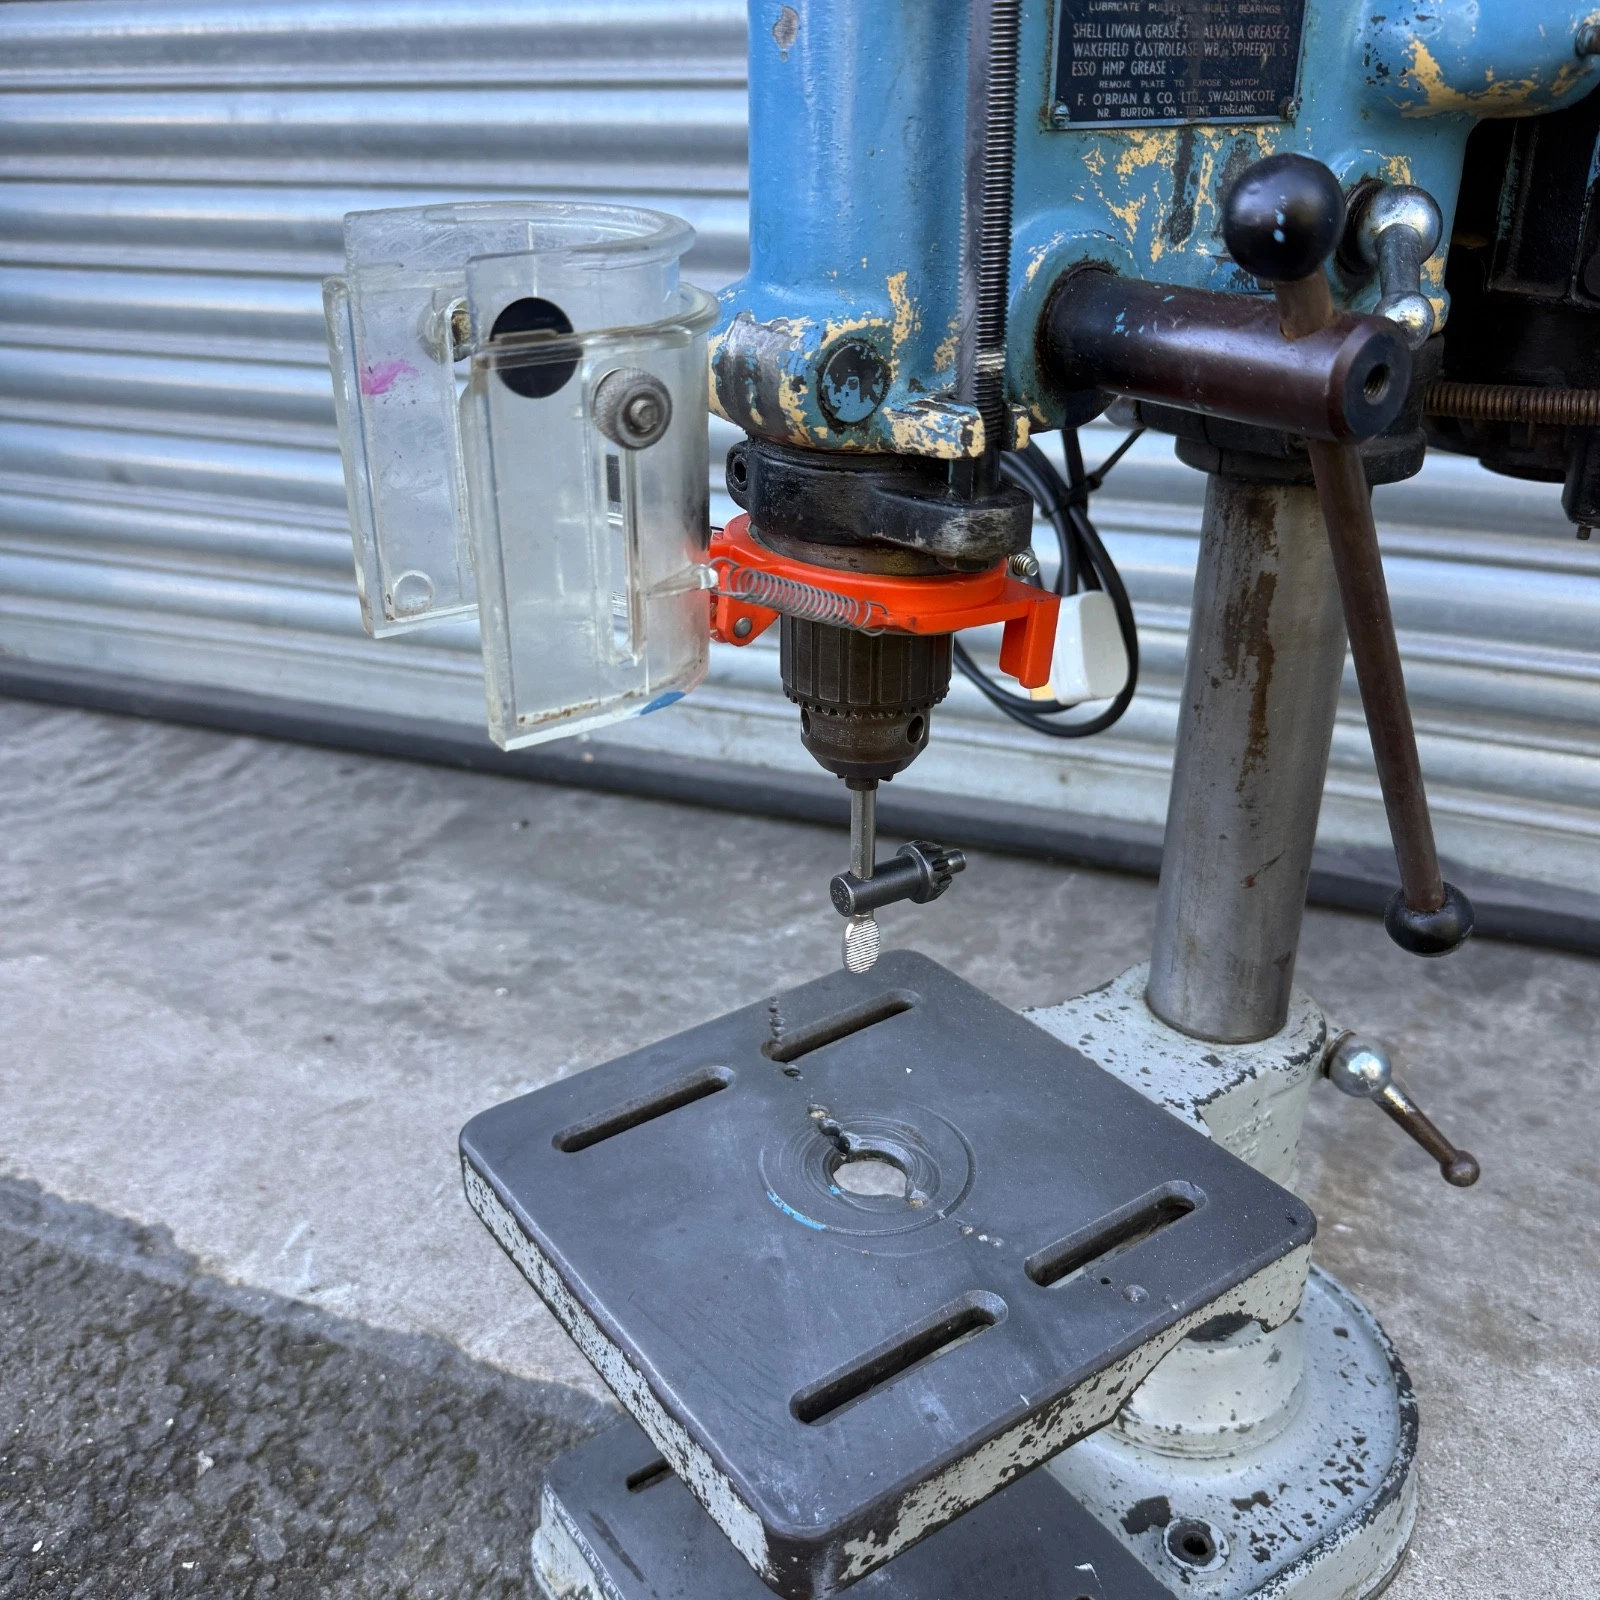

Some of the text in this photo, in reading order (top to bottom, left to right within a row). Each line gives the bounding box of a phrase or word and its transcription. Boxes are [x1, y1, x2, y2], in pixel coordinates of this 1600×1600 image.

[1089, 2, 1141, 12] LUBRICATE
[1238, 4, 1281, 14] BEARINGS
[1073, 23, 1102, 39] SHELL
[1106, 24, 1142, 39] LIVONA
[1144, 24, 1180, 39] GREASE
[1181, 24, 1189, 39] 3
[1203, 24, 1245, 40] ALVANIA
[1247, 24, 1281, 40] GREASE
[1283, 25, 1290, 40] 2
[1073, 41, 1129, 57] WAKEFIELD
[1134, 41, 1198, 57] CASTROLEASE
[1231, 42, 1277, 57] SPHEEROL
[1071, 60, 1167, 77] ESSO HMP GREASE
[1099, 78, 1260, 89] REMOVE PLATE TO EXPOSE SWITCH
[1077, 93, 1087, 107] F.
[1092, 92, 1138, 106] O'BRIAN
[1143, 92, 1151, 105] &
[1156, 91, 1175, 105] CO.
[1208, 89, 1277, 103] SWADLINCOTE
[1097, 108, 1112, 119] NR.
[1120, 106, 1155, 118] BURTON
[1219, 103, 1257, 116] ENGLAND.
